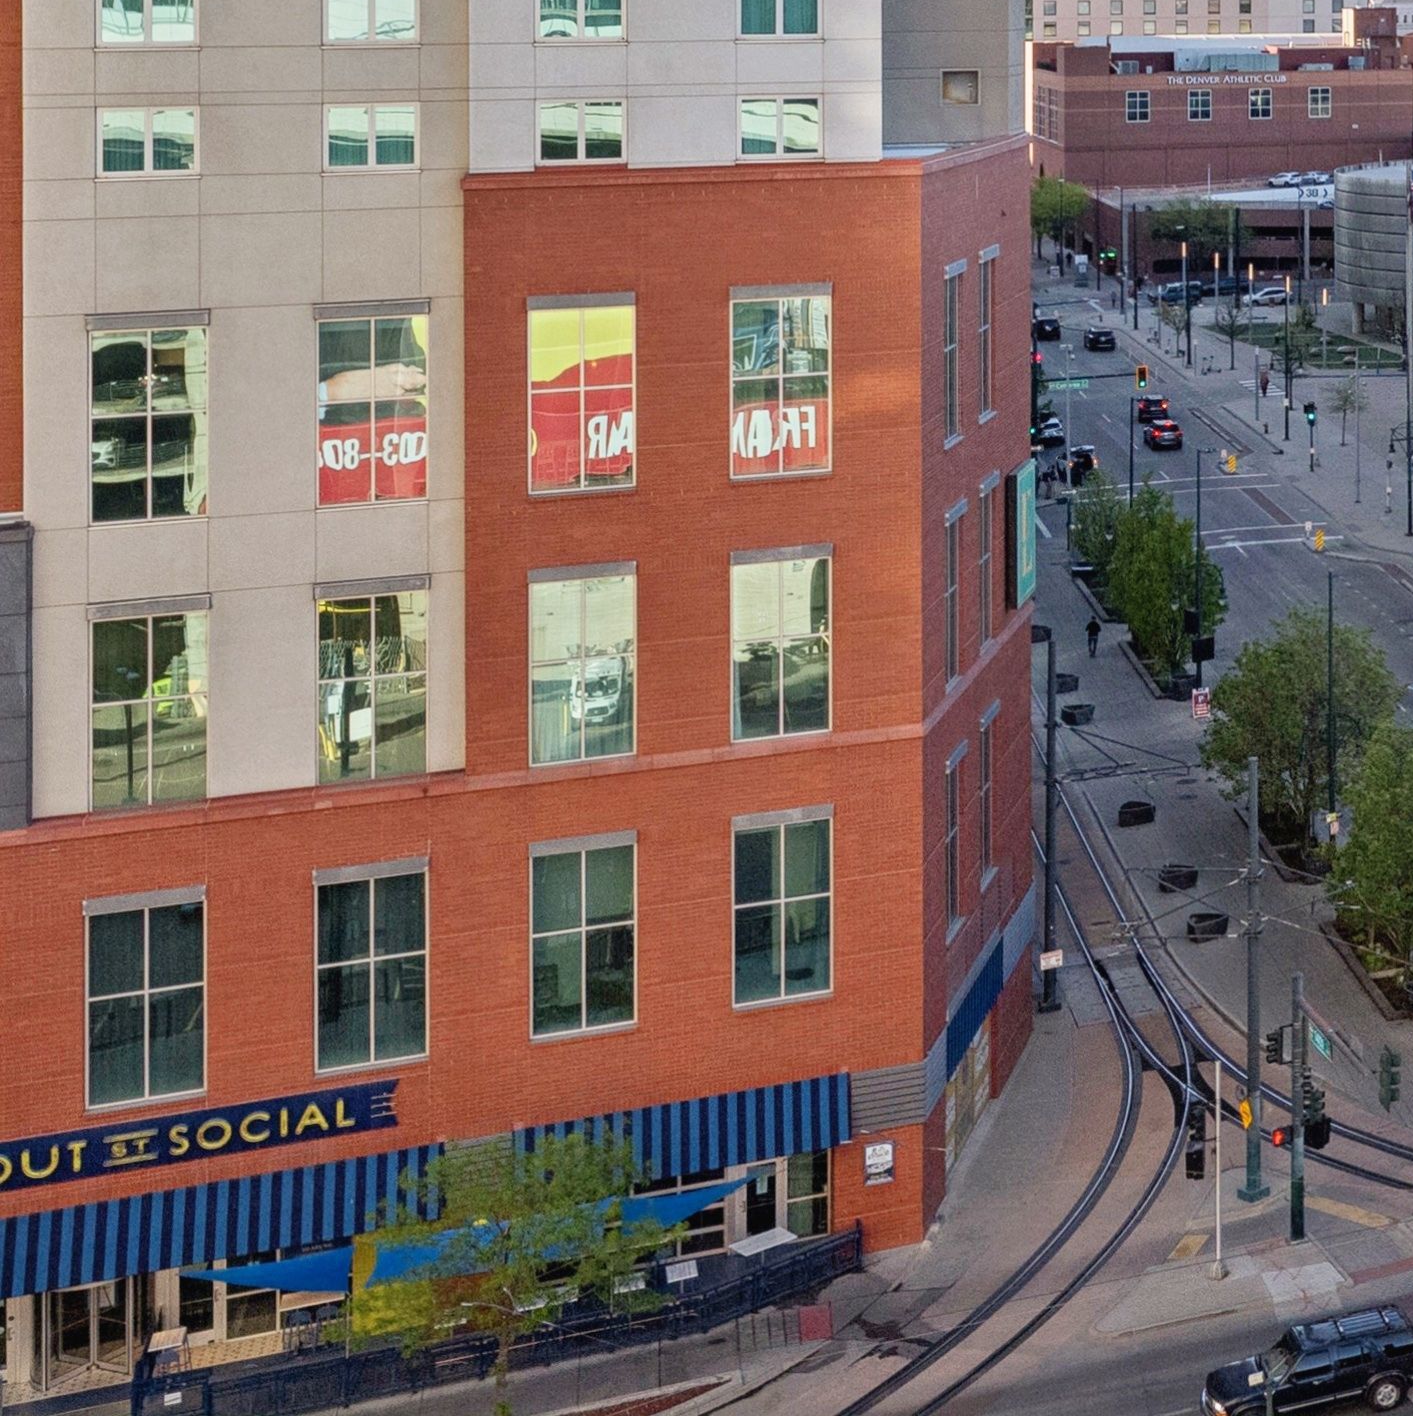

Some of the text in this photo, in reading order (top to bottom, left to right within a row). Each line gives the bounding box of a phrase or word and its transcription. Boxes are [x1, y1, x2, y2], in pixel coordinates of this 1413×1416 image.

[1167, 73, 1287, 85] THE DENVER ATHLETIC CLUB
[110, 1137, 149, 1158] ST
[169, 1097, 356, 1157] SOCIAL
